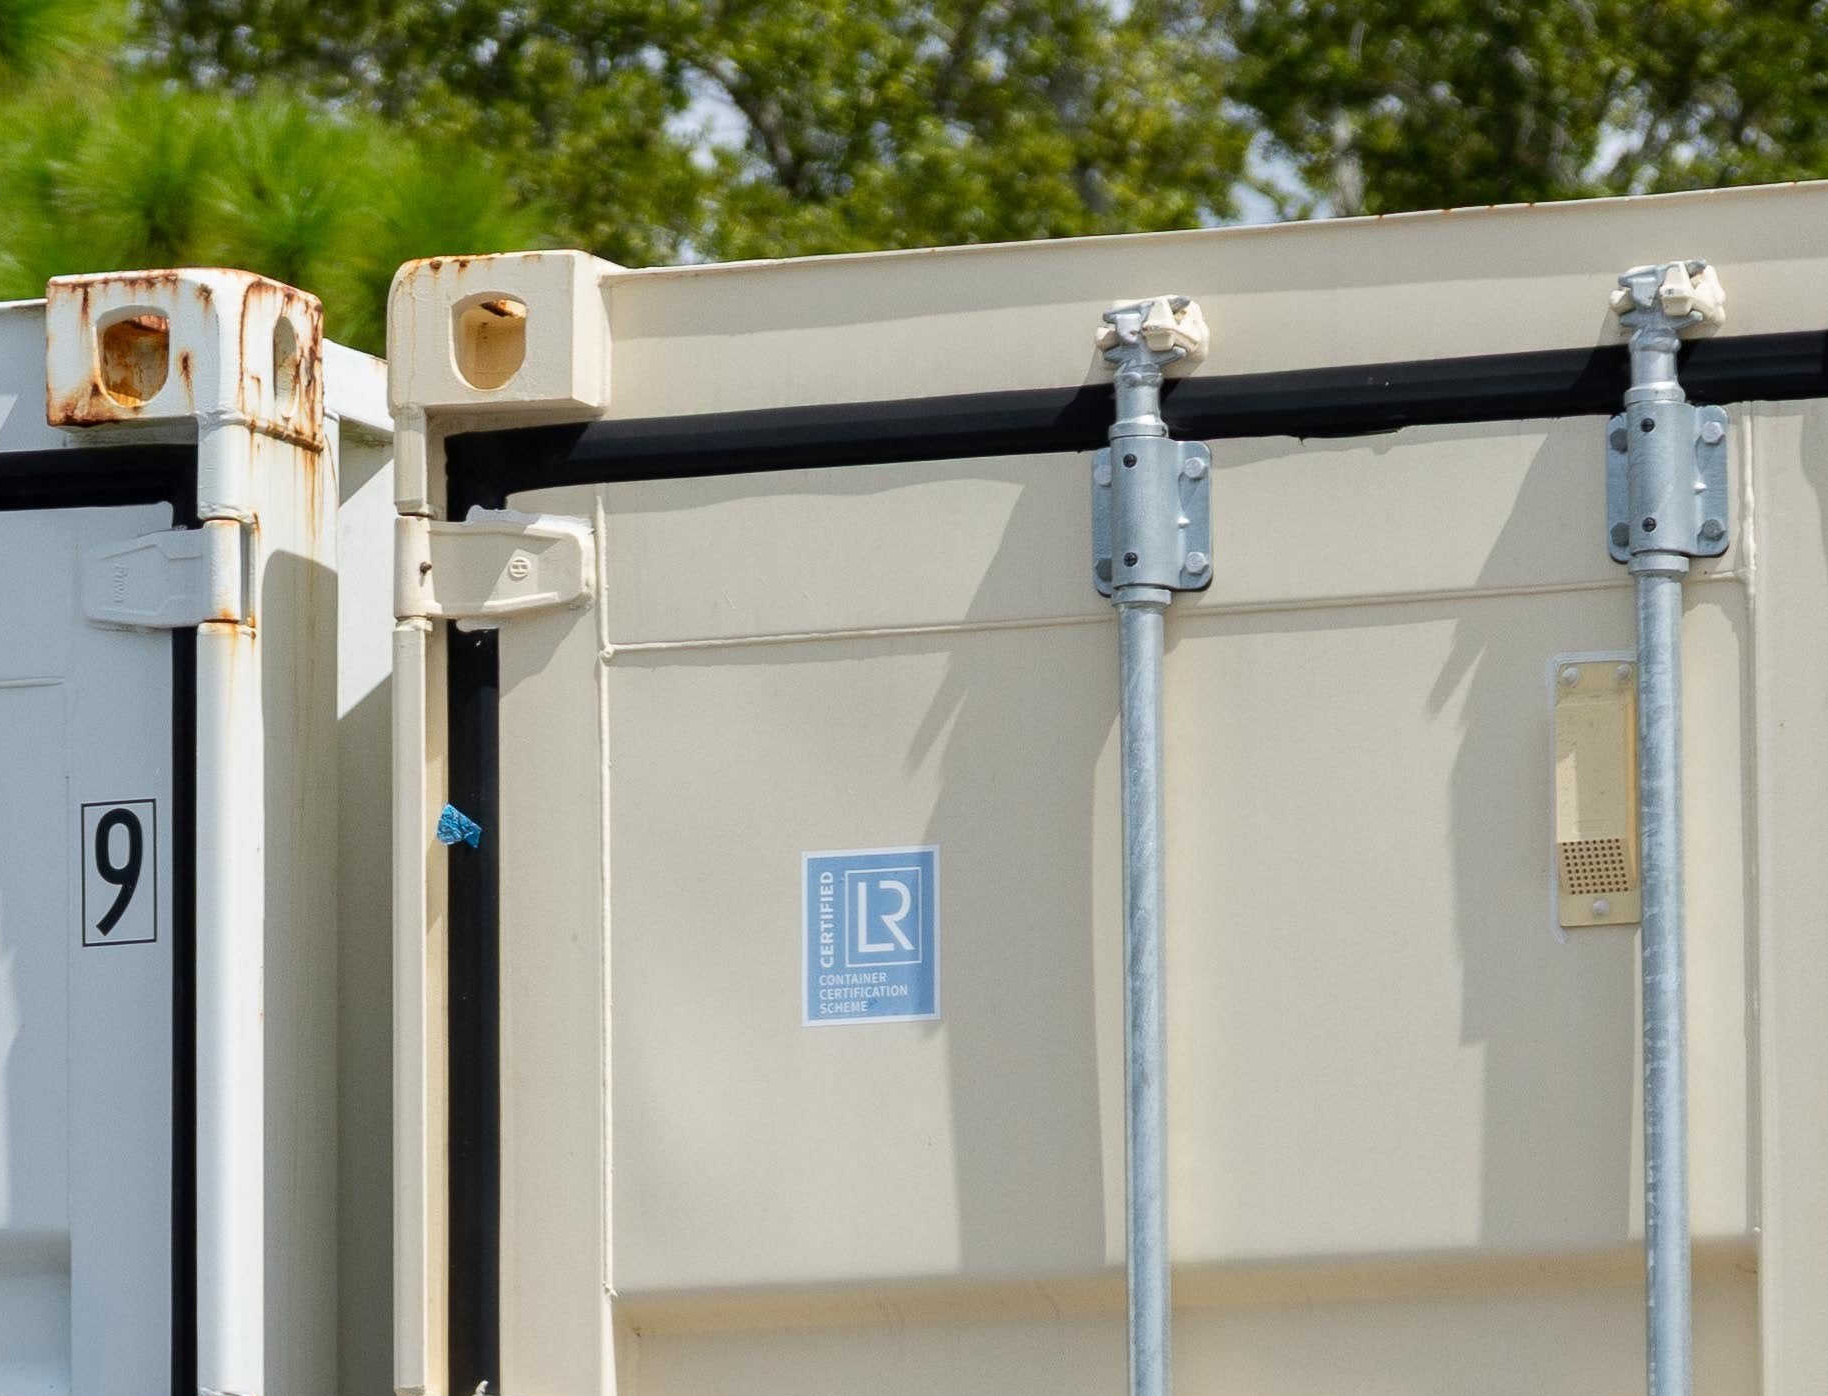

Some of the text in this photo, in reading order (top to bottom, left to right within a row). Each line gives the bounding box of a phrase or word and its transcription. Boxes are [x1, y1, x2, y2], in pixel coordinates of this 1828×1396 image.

[94, 808, 144, 938] 9
[820, 871, 835, 968] CERTIFIED
[819, 972, 887, 986] CONTAINER
[819, 985, 908, 1000] CERTIFICATION
[820, 1000, 868, 1014] SCHEME
